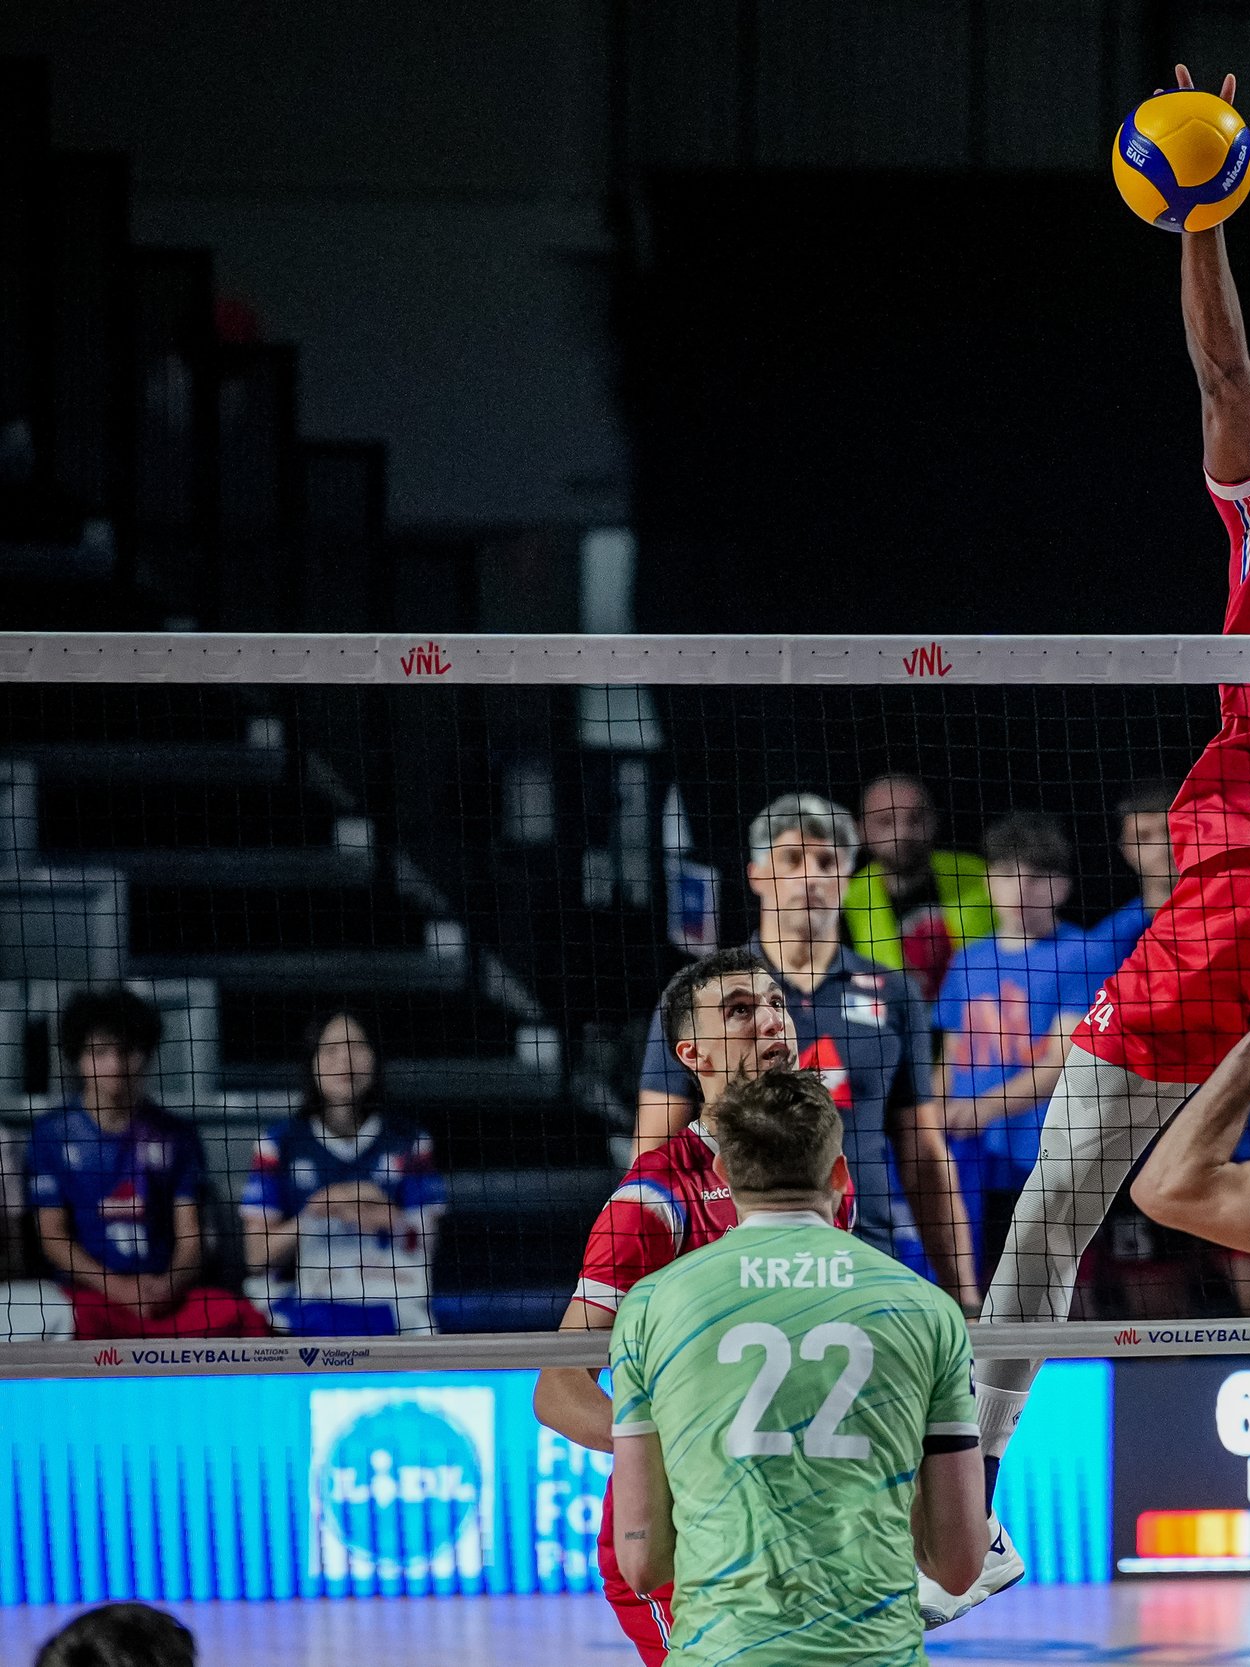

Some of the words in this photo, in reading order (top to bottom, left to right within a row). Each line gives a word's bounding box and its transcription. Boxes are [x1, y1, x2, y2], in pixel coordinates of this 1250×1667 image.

[401, 641, 452, 677] VNL
[903, 641, 952, 677] VNL
[739, 1249, 855, 1289] KRŽIČ
[1114, 1327, 1142, 1346] VNL
[94, 1347, 123, 1367] VNL
[131, 1349, 250, 1365] VOLLEYBALL
[253, 1348, 289, 1356] NATIONS
[321, 1348, 370, 1359] Volleyball
[321, 1357, 354, 1367] World
[716, 1322, 875, 1460] 22
